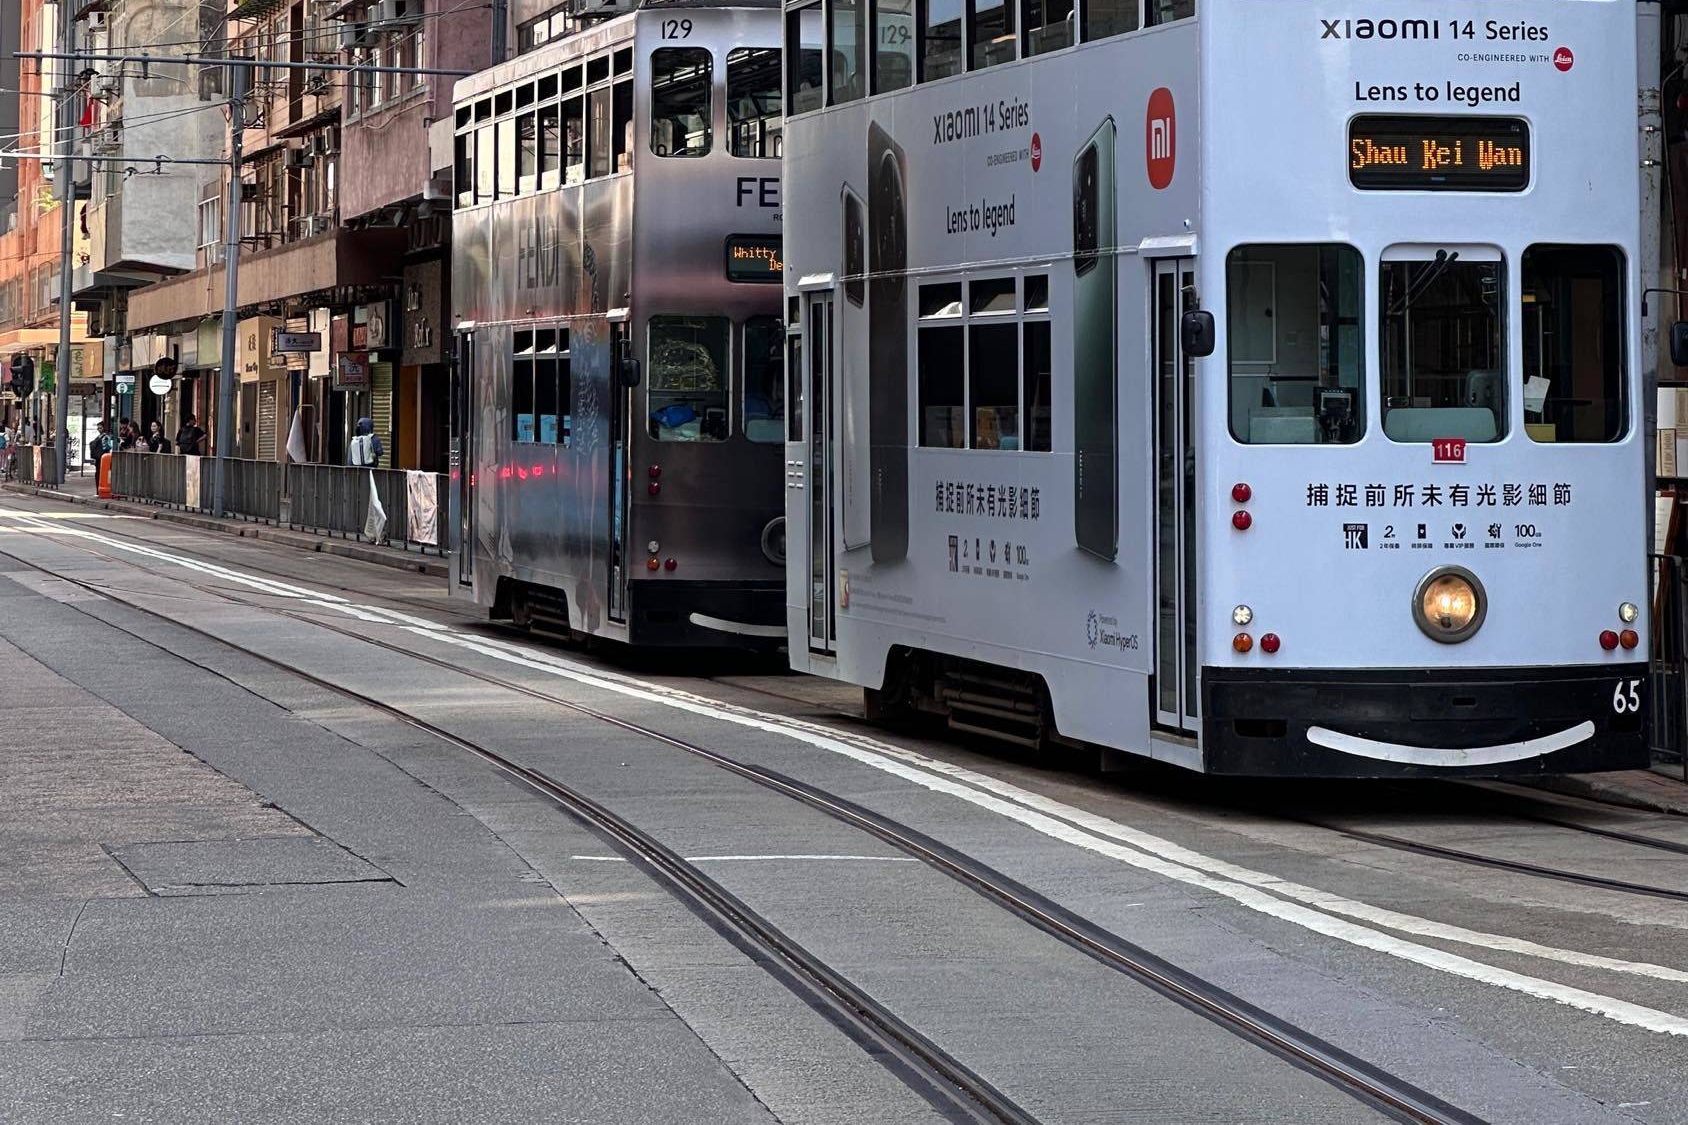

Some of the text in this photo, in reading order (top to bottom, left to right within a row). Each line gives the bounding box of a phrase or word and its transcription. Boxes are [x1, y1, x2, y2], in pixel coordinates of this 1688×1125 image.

[661, 19, 693, 40] 129
[1449, 20, 1476, 40] 14
[1485, 20, 1549, 41] Series
[1457, 53, 1527, 63] CO-ENGINEERED
[1529, 54, 1550, 63] WITH
[1355, 81, 1521, 107] Lens to legend
[983, 103, 995, 134] 14
[999, 96, 1029, 131] Series
[1352, 138, 1522, 170] Shau Kei Wan
[946, 193, 1015, 237] Lens to legend
[518, 213, 559, 290] FENDI
[734, 246, 776, 260] Whitty
[1437, 443, 1462, 458] 116
[936, 480, 1040, 521] 捕捉前所未有光影細節
[1306, 483, 1572, 508] 捕捉前所未有光影細節
[1343, 531, 1363, 549] HK
[1613, 679, 1640, 713] 65
